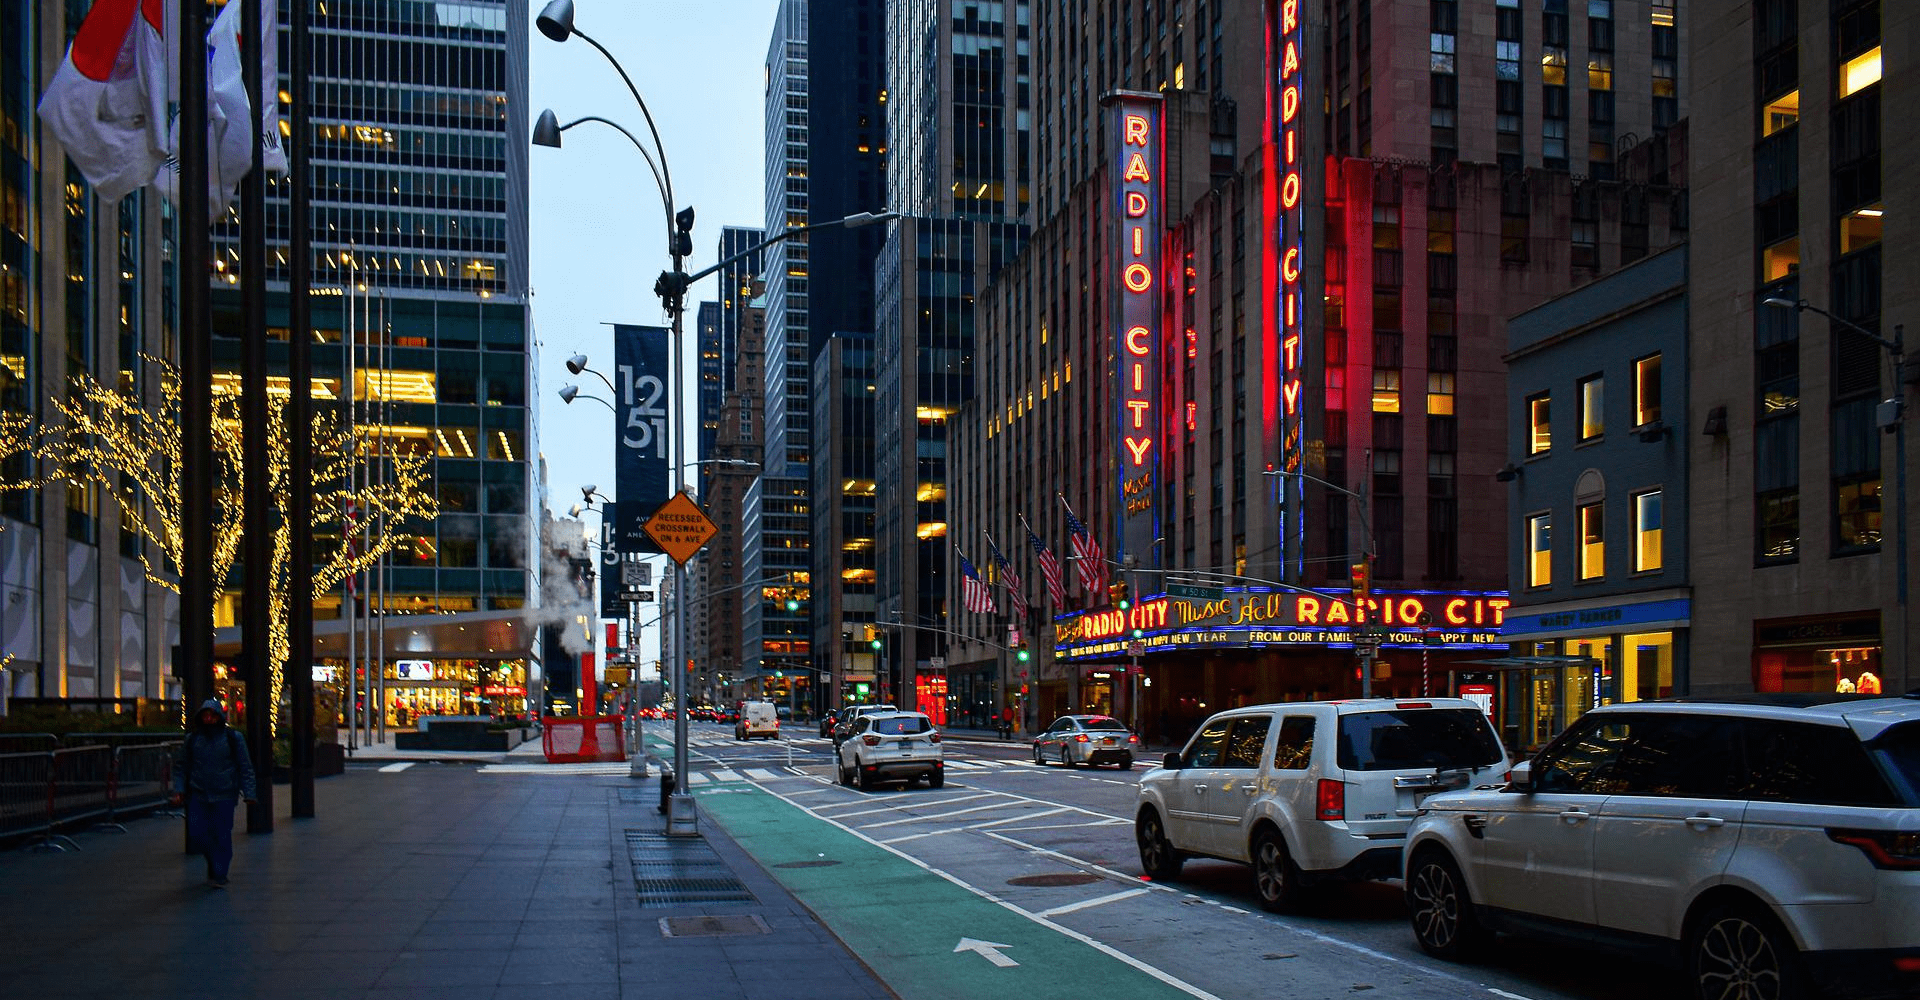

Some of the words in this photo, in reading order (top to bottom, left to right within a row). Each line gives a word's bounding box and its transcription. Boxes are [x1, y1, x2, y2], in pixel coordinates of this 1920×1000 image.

[1282, 0, 1299, 208] RADIO
[1125, 115, 1152, 292] RADIO
[1284, 248, 1299, 414] CITY
[1125, 327, 1151, 465] CITY
[658, 513, 702, 523] RECESSED
[655, 524, 705, 533] CROSSWALK
[661, 535, 672, 543] ON
[1200, 589, 1208, 597] St
[1174, 598, 1231, 626] Music
[1228, 593, 1282, 625] Hall
[1540, 613, 1576, 627] WARBY
[1579, 609, 1622, 623] PARKER
[1084, 610, 1125, 639] RADIO
[1172, 633, 1190, 644] NEW
[1196, 632, 1227, 642] YEAR
[1249, 631, 1282, 642] FROM
[1288, 632, 1312, 642] OUR
[1319, 632, 1360, 642] FAMIL
[1440, 634, 1466, 643] APPY
[1472, 634, 1495, 643] NEW
